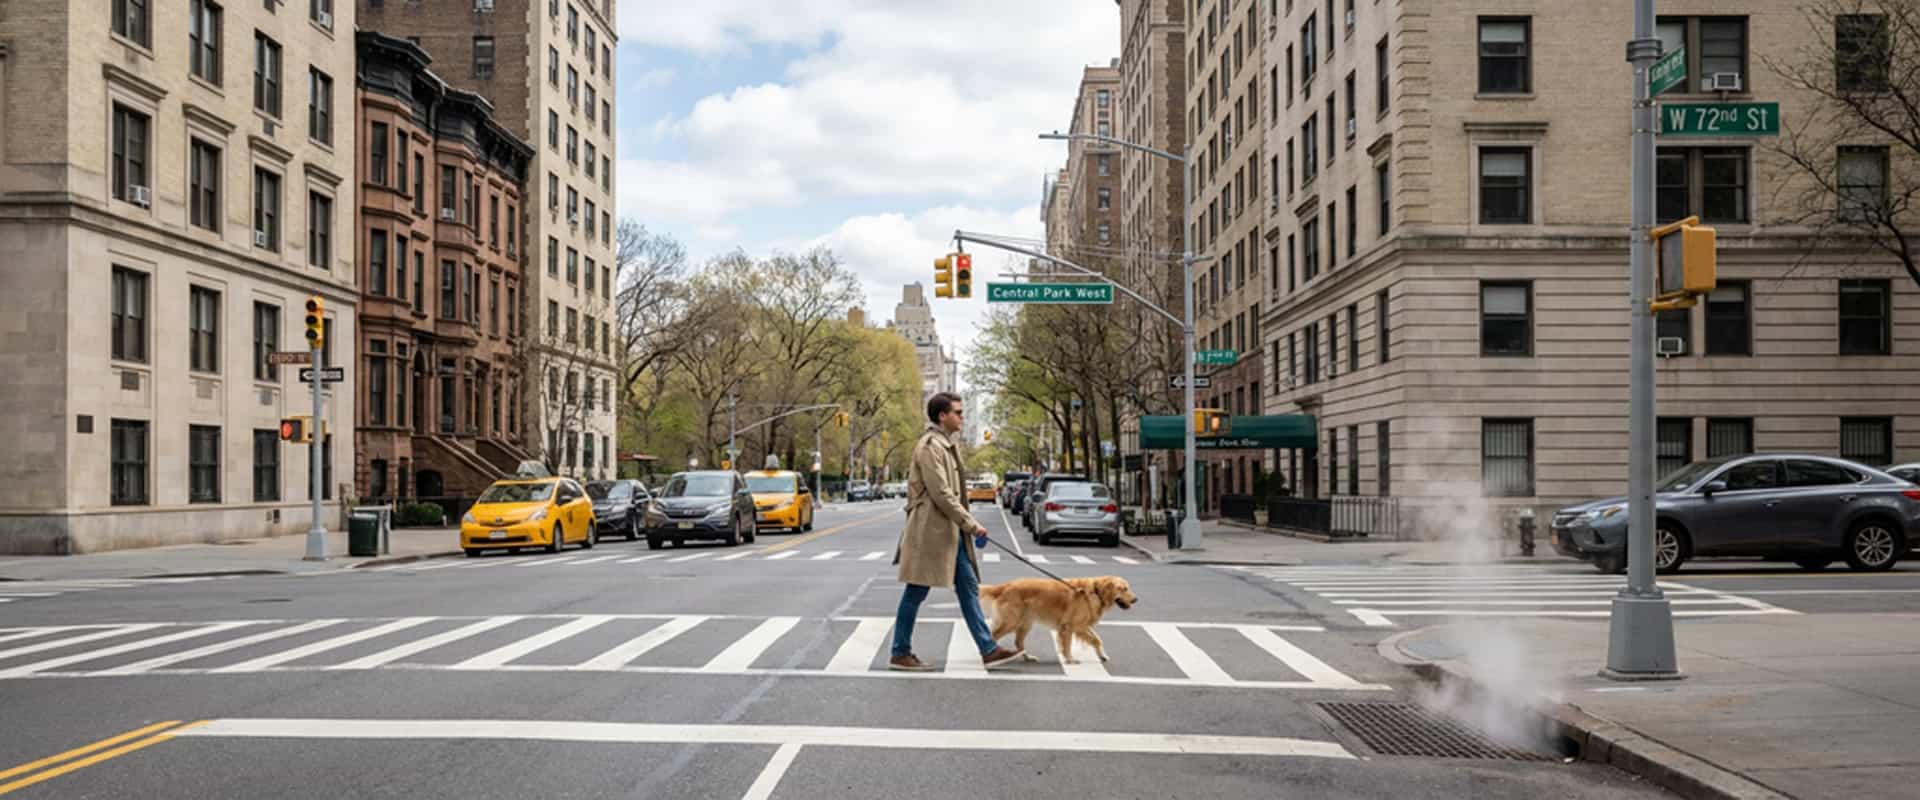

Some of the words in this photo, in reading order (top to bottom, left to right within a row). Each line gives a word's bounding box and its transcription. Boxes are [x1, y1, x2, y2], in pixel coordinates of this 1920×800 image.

[1670, 108, 1686, 131] W
[1695, 108, 1737, 131] 72nd
[1747, 108, 1768, 131] St
[993, 287, 1038, 298] Central
[1043, 287, 1071, 298] Park
[1076, 288, 1106, 298] West
